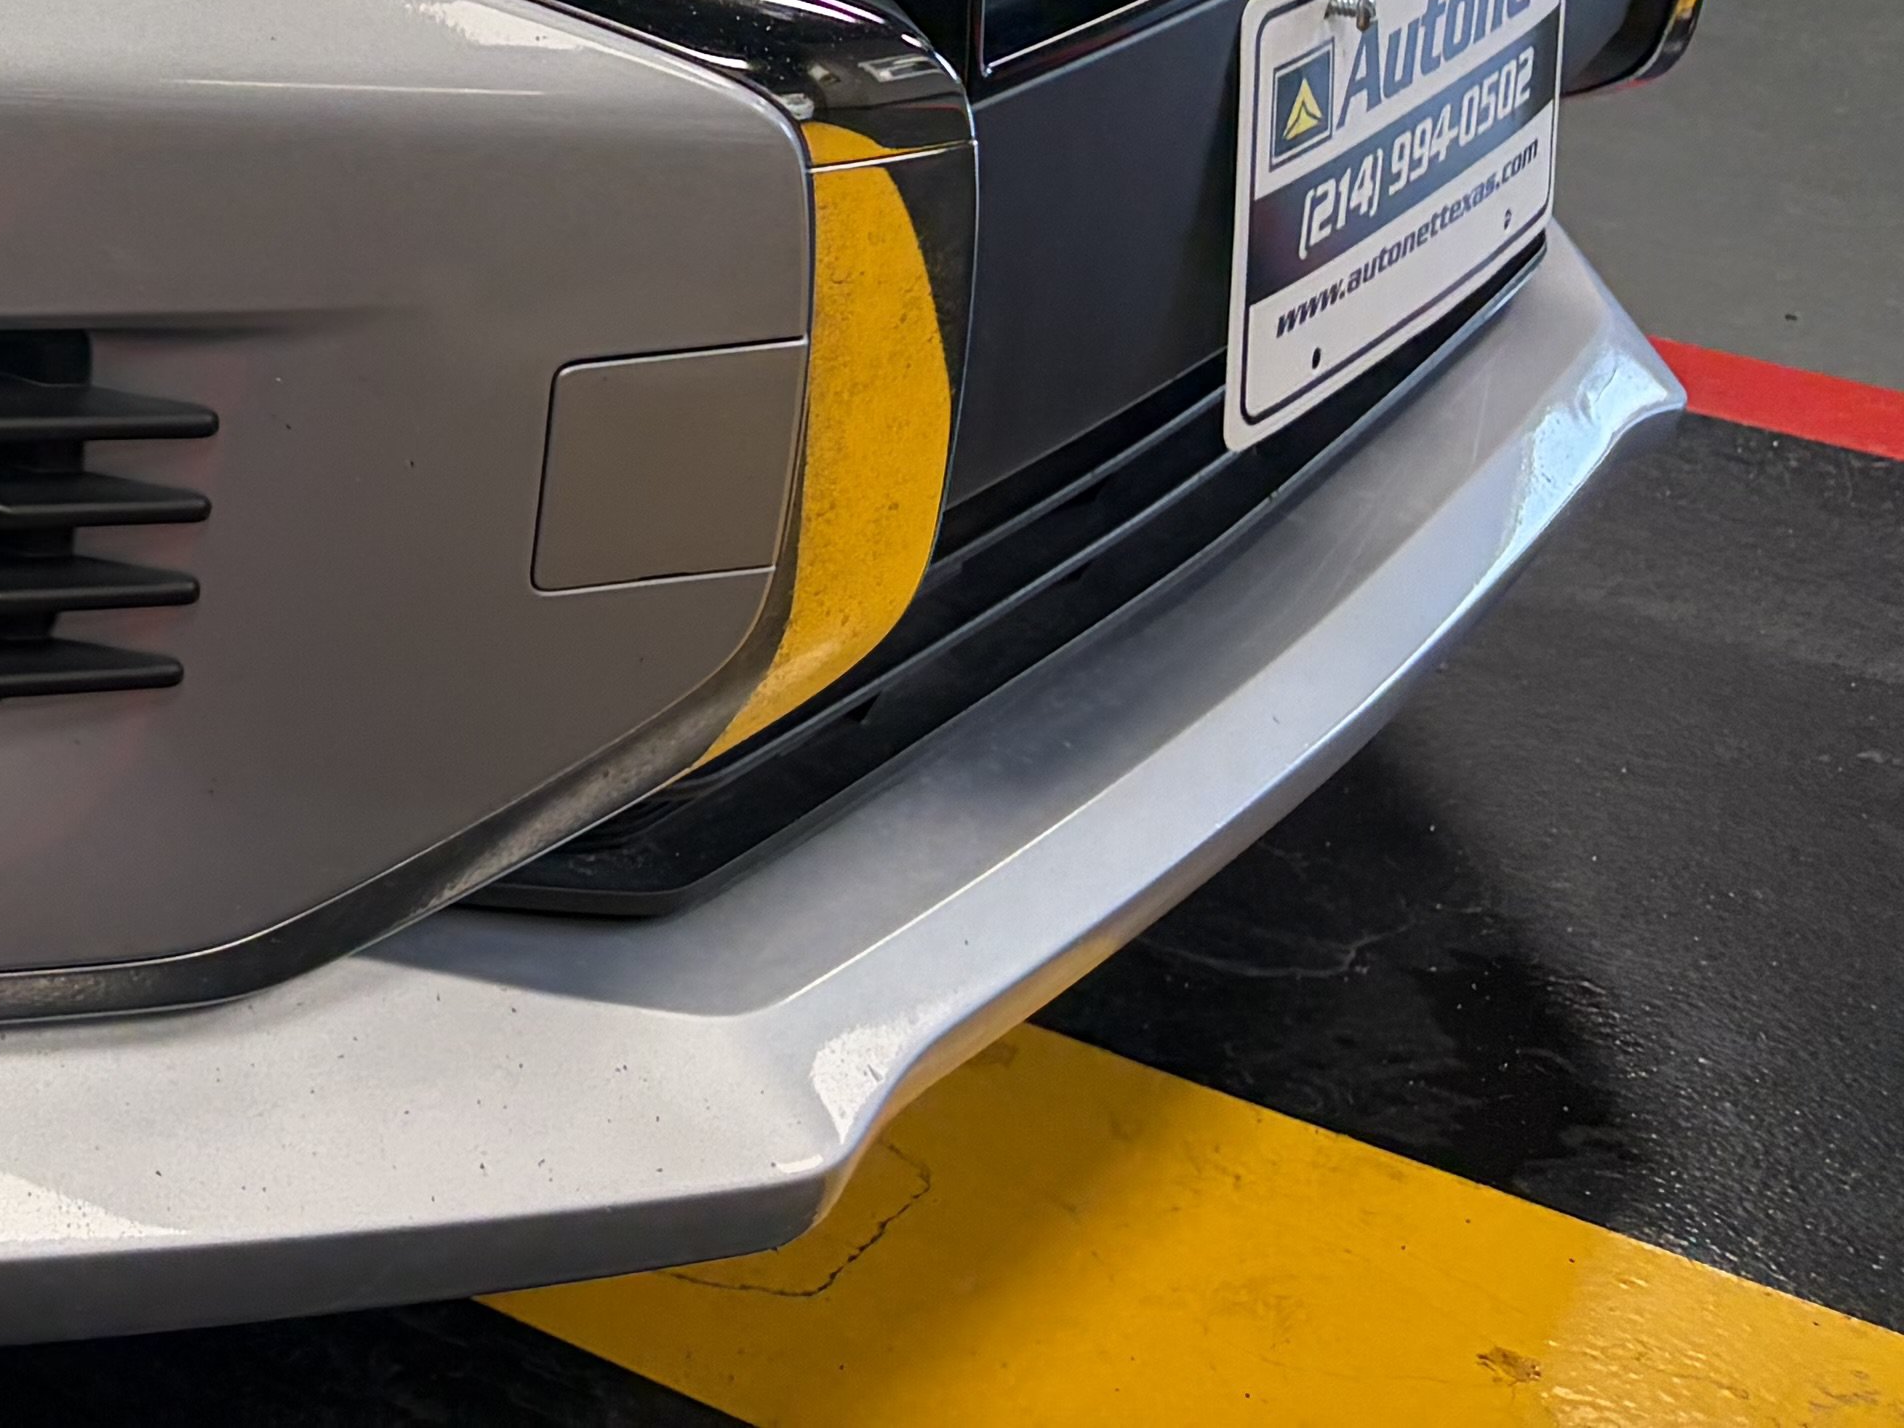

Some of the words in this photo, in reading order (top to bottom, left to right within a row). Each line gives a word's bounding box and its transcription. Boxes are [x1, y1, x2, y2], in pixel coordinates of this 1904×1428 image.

[1275, 137, 1539, 338] www.autonettexas.com
[1298, 147, 1384, 260] (214)
[1388, 45, 1535, 197] 994-0502
